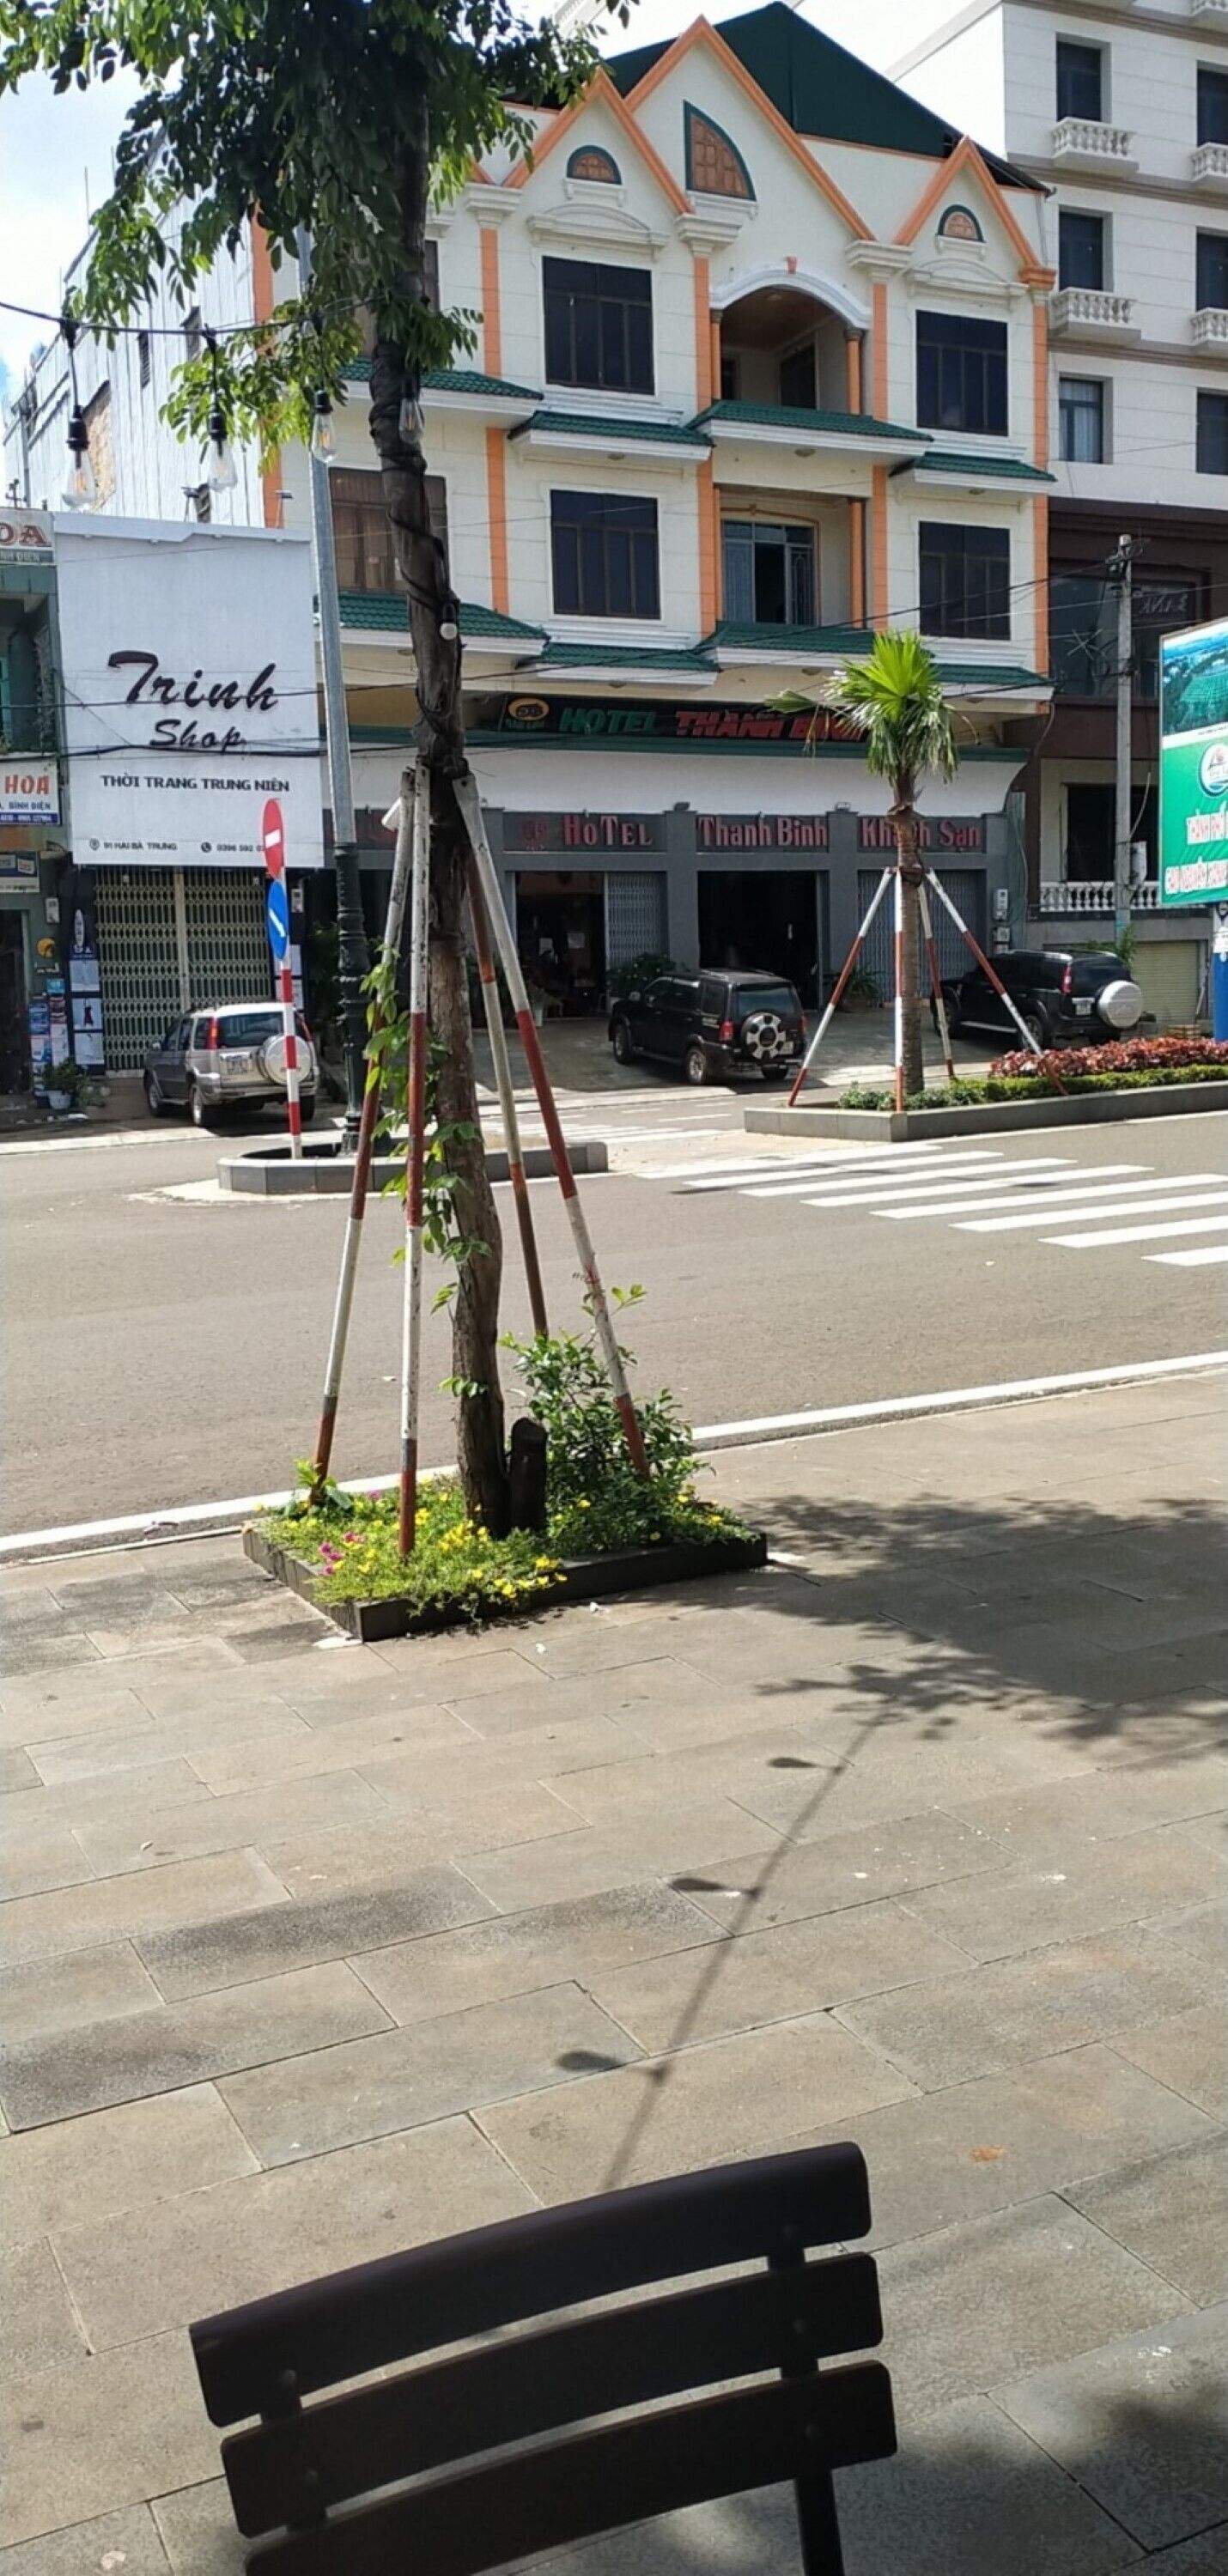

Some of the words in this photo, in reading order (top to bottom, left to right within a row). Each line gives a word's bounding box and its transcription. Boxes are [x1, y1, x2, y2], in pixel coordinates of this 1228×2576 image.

[560, 708, 657, 734] HOTEL
[149, 719, 247, 756] Shop
[144, 775, 198, 789] TRANG
[200, 778, 252, 791] TRUNG
[698, 817, 771, 846] Thanh
